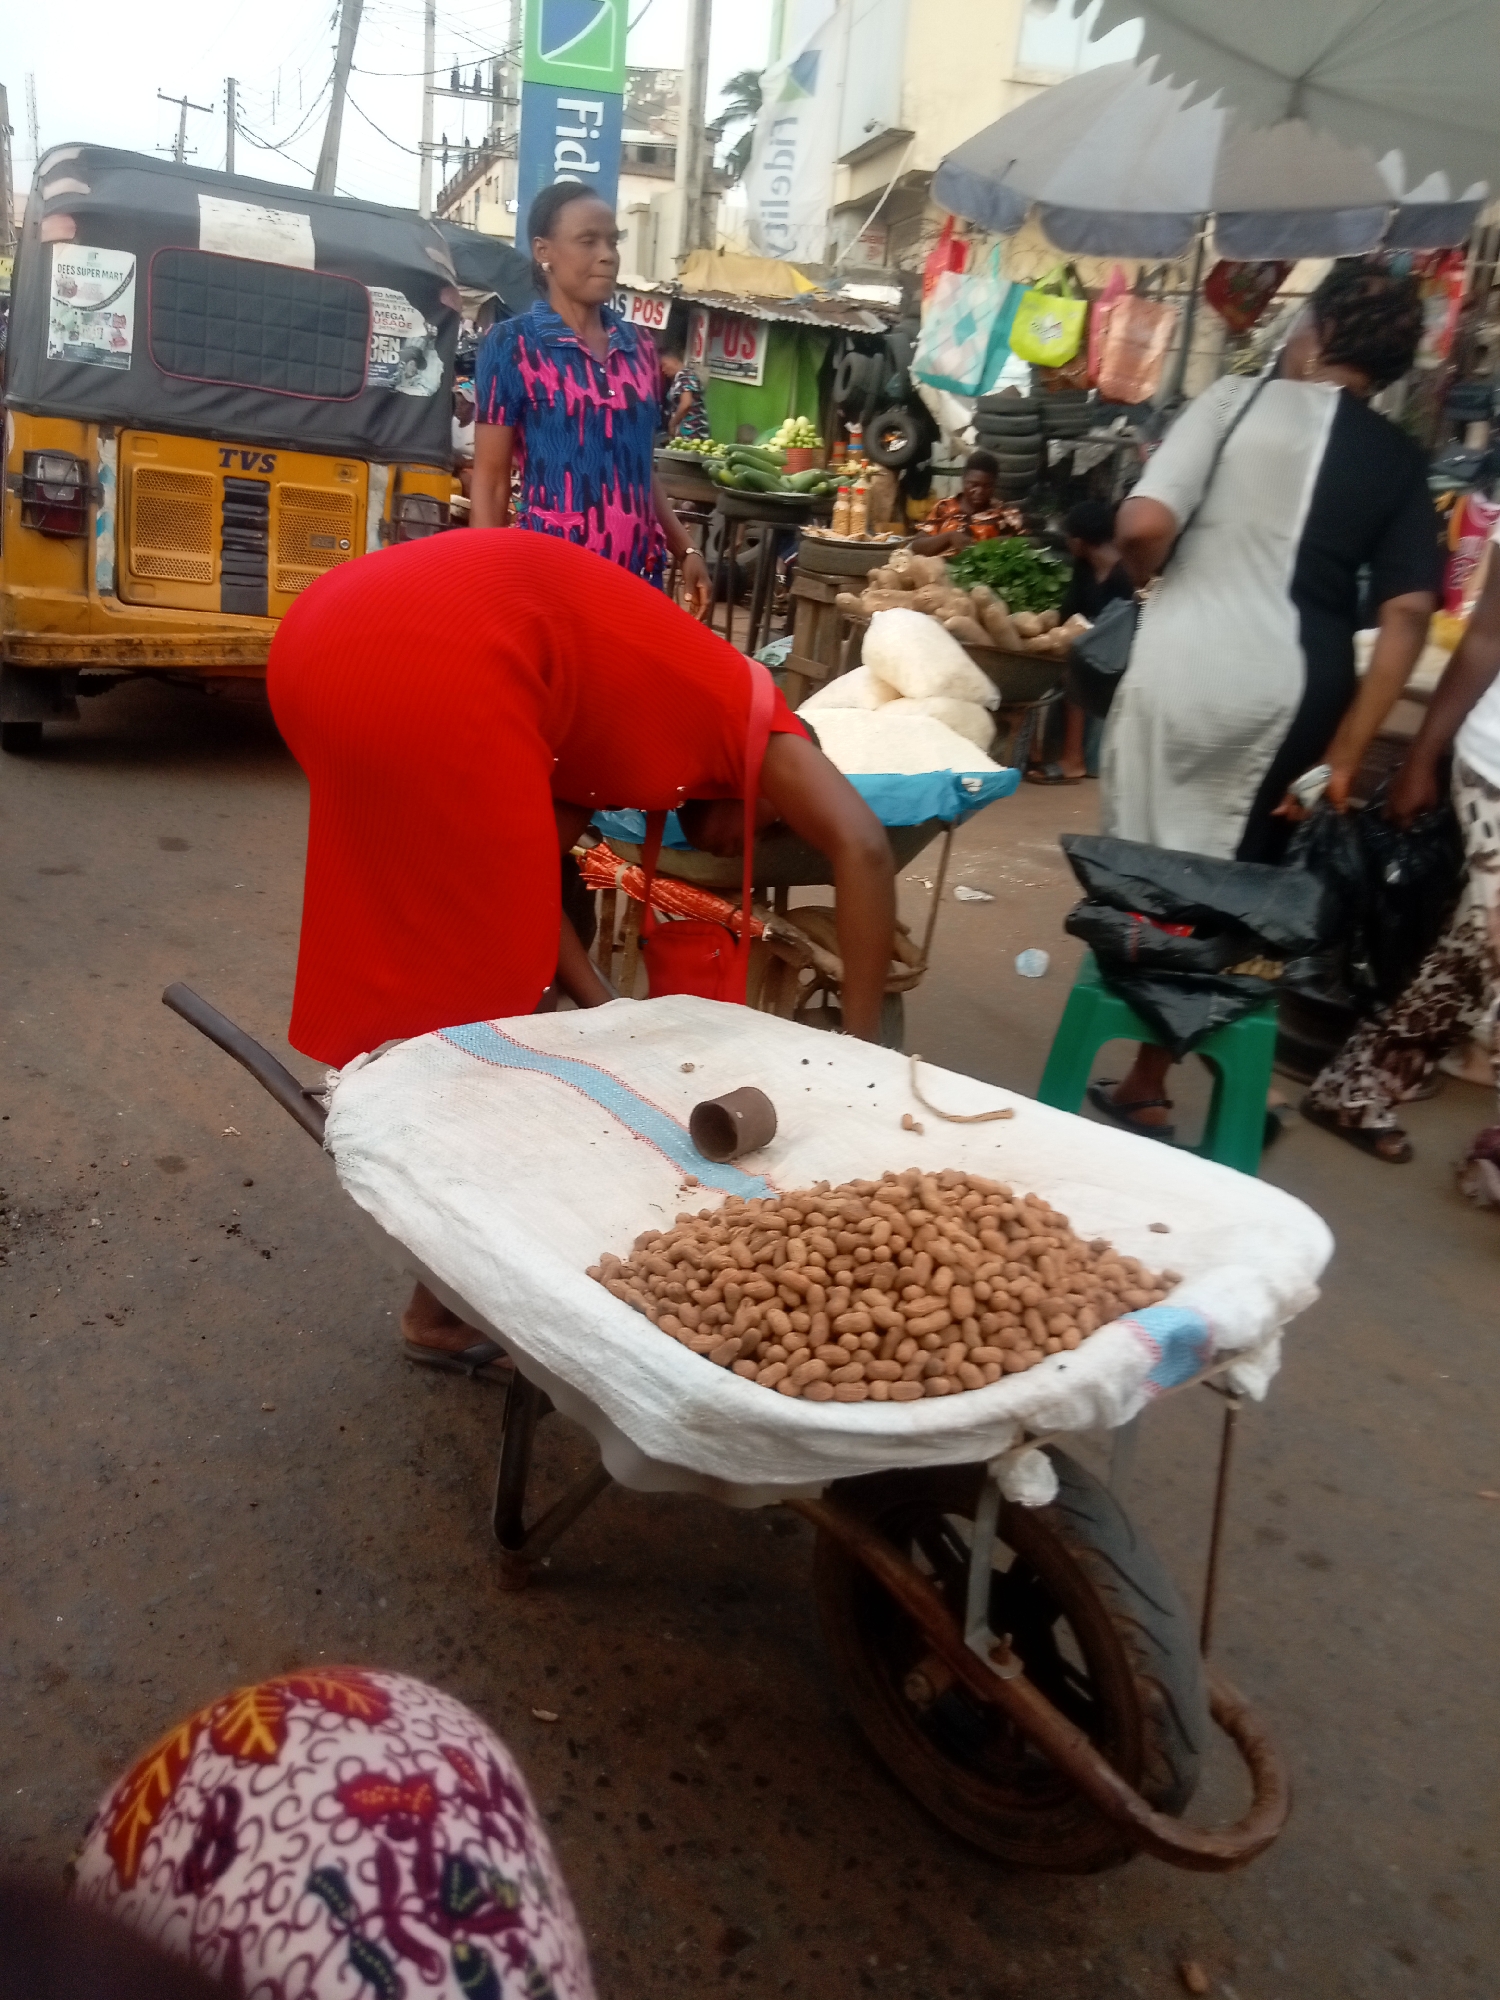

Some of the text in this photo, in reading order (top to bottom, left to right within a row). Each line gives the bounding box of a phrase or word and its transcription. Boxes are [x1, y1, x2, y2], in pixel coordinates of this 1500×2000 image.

[57, 263, 76, 276] DEES
[76, 266, 101, 279] SUPER
[102, 270, 124, 282] MART
[374, 310, 405, 322] MEGA
[631, 296, 664, 325] POS
[708, 313, 759, 360] POS
[218, 447, 277, 474] TVS
